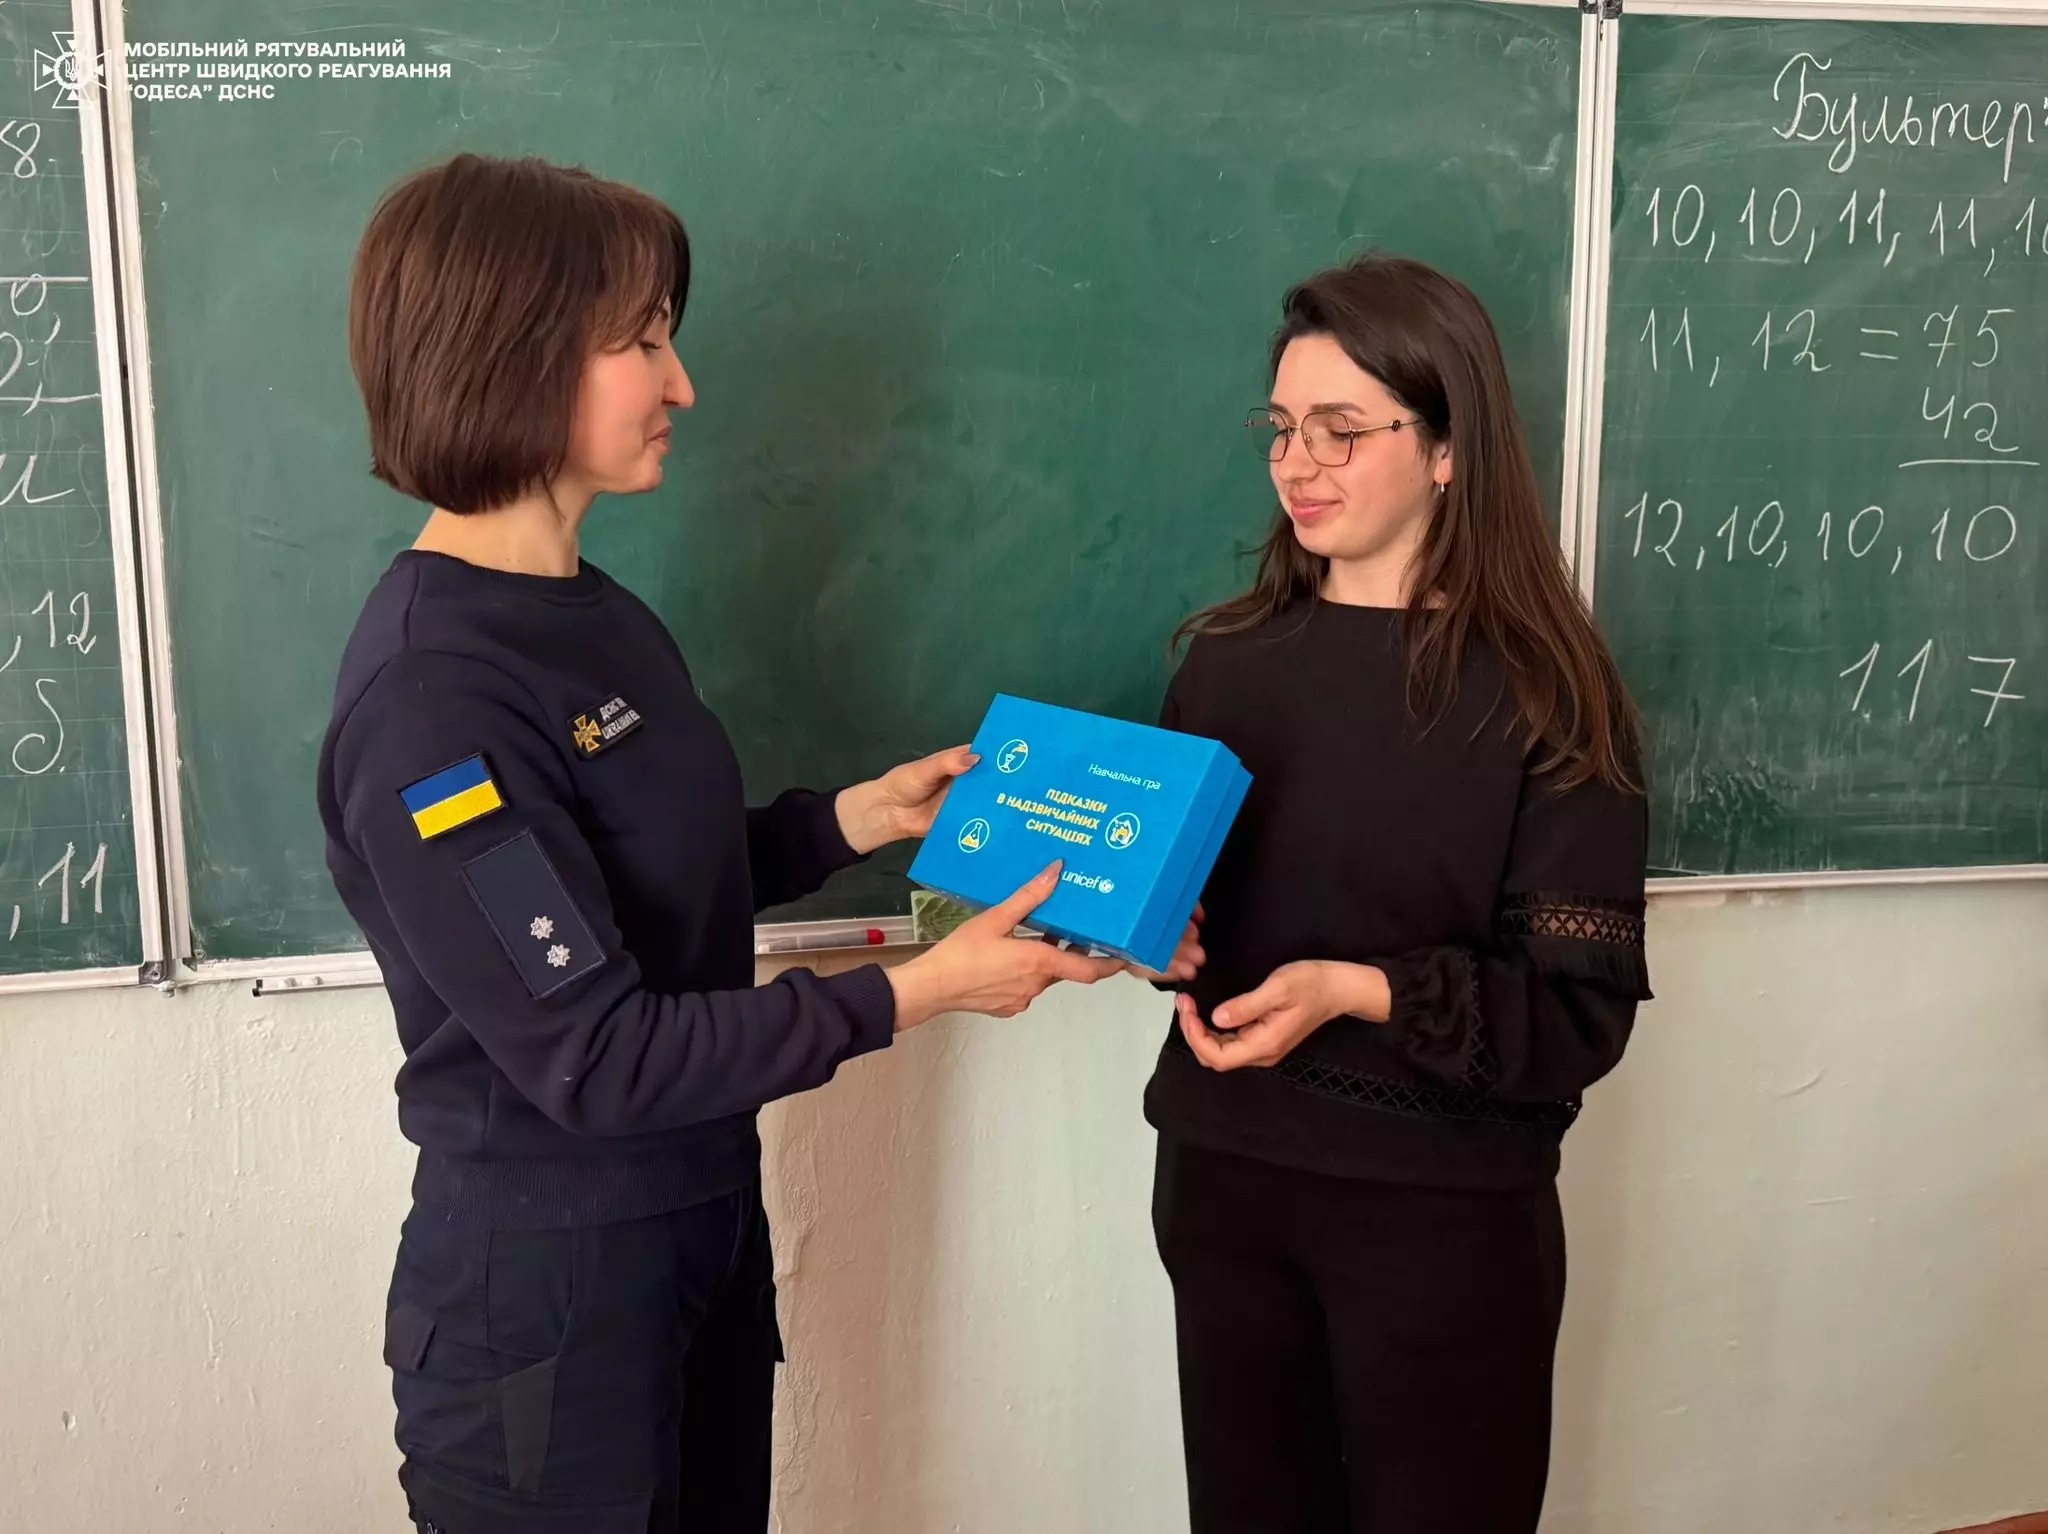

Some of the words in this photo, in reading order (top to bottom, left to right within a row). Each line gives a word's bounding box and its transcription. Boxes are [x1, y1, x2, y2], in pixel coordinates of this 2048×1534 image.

[1752, 309, 1832, 372] 12
[1922, 387, 2019, 452] 42
[1931, 505, 2016, 561] 10
[1839, 639, 2026, 727] 117
[1088, 763, 1142, 785] Навчальна
[1141, 778, 1161, 791] гра
[996, 792, 1006, 804] В
[1006, 795, 1101, 830] НАДЗВИЧАЙНИХ
[1045, 788, 1108, 814] ПІДКАЗКИ
[1025, 818, 1093, 846] СИТУАЦІЯХ
[1062, 870, 1101, 888] unicef
